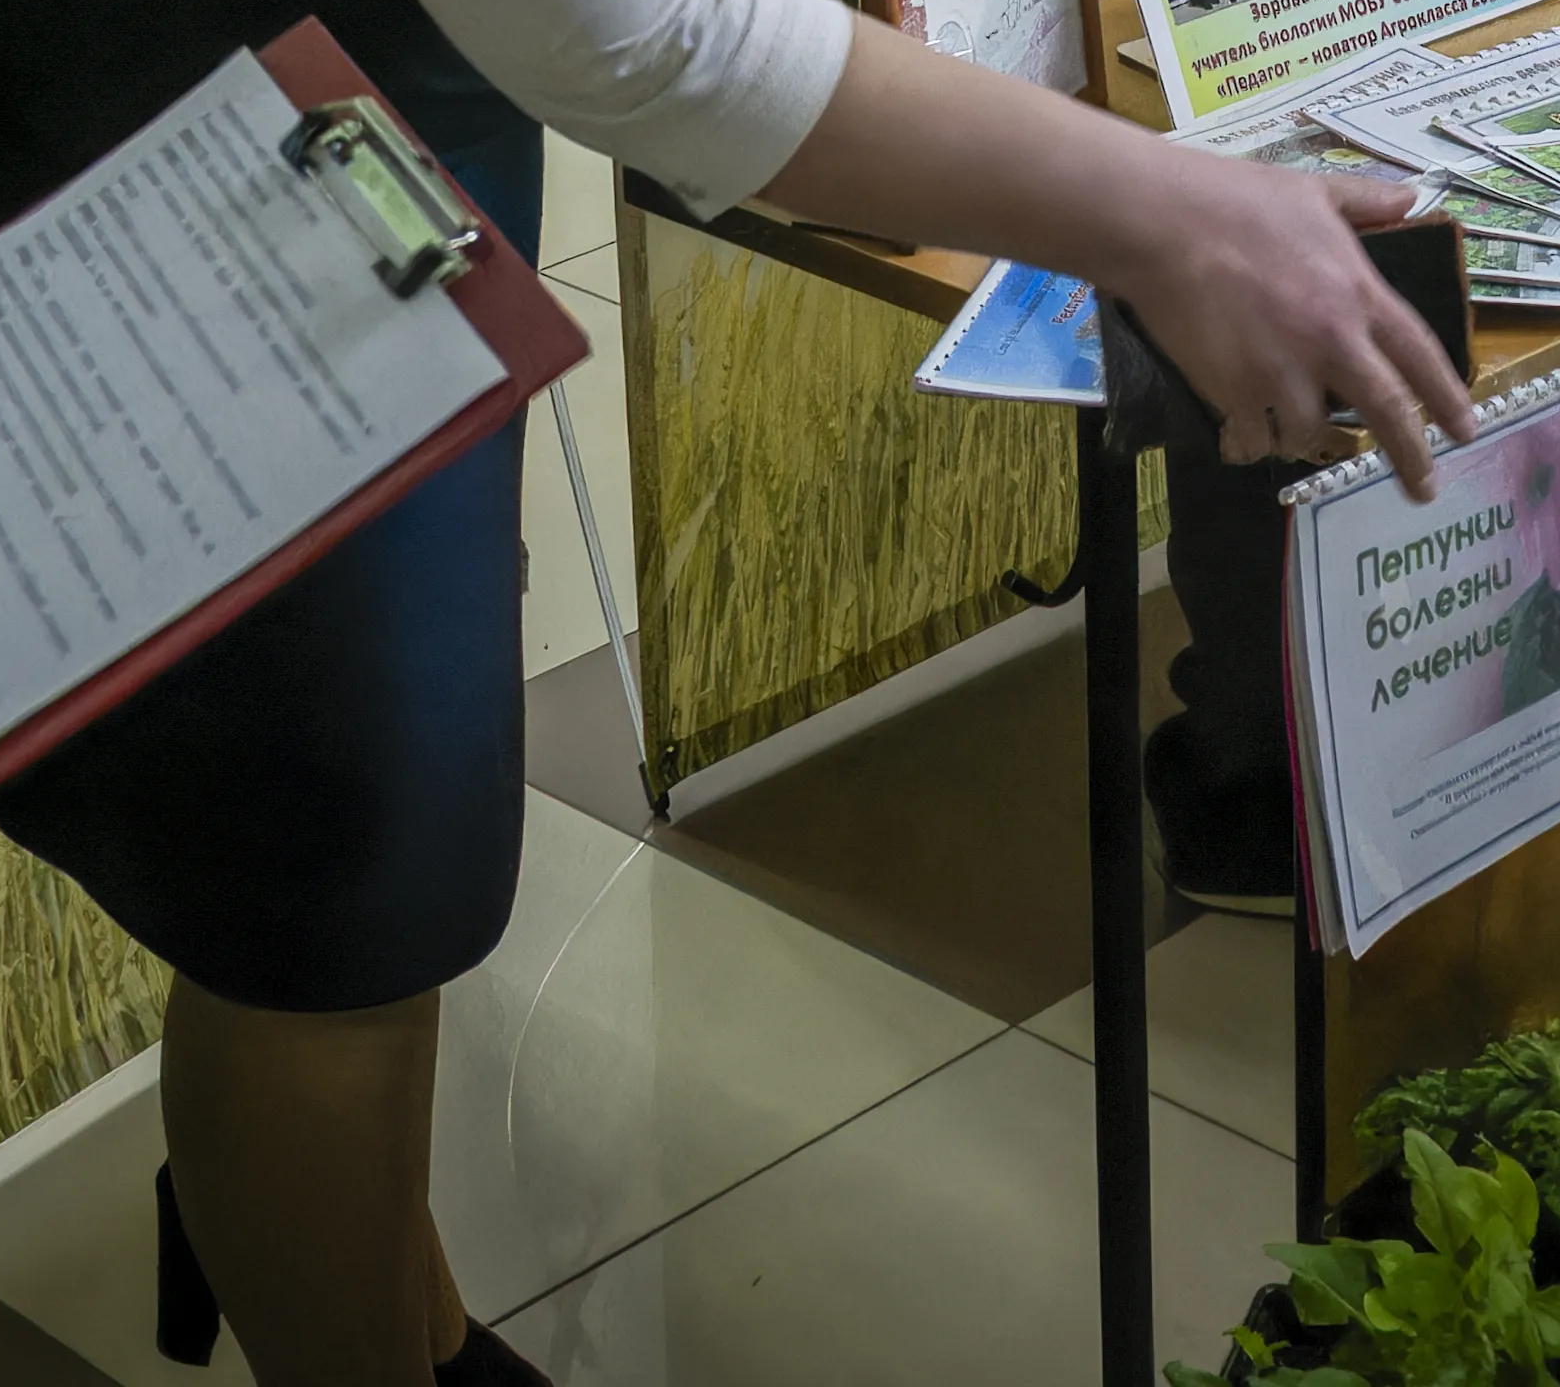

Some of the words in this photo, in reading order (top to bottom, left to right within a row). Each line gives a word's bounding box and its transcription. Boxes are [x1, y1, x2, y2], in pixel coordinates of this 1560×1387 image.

[1192, 43, 1258, 80] учитель
[1258, 12, 1338, 53] биологии
[1216, 60, 1293, 99] «Педагог
[1354, 498, 1516, 597] Петунии
[1366, 556, 1513, 651] болезни
[1370, 616, 1513, 714] лечение
